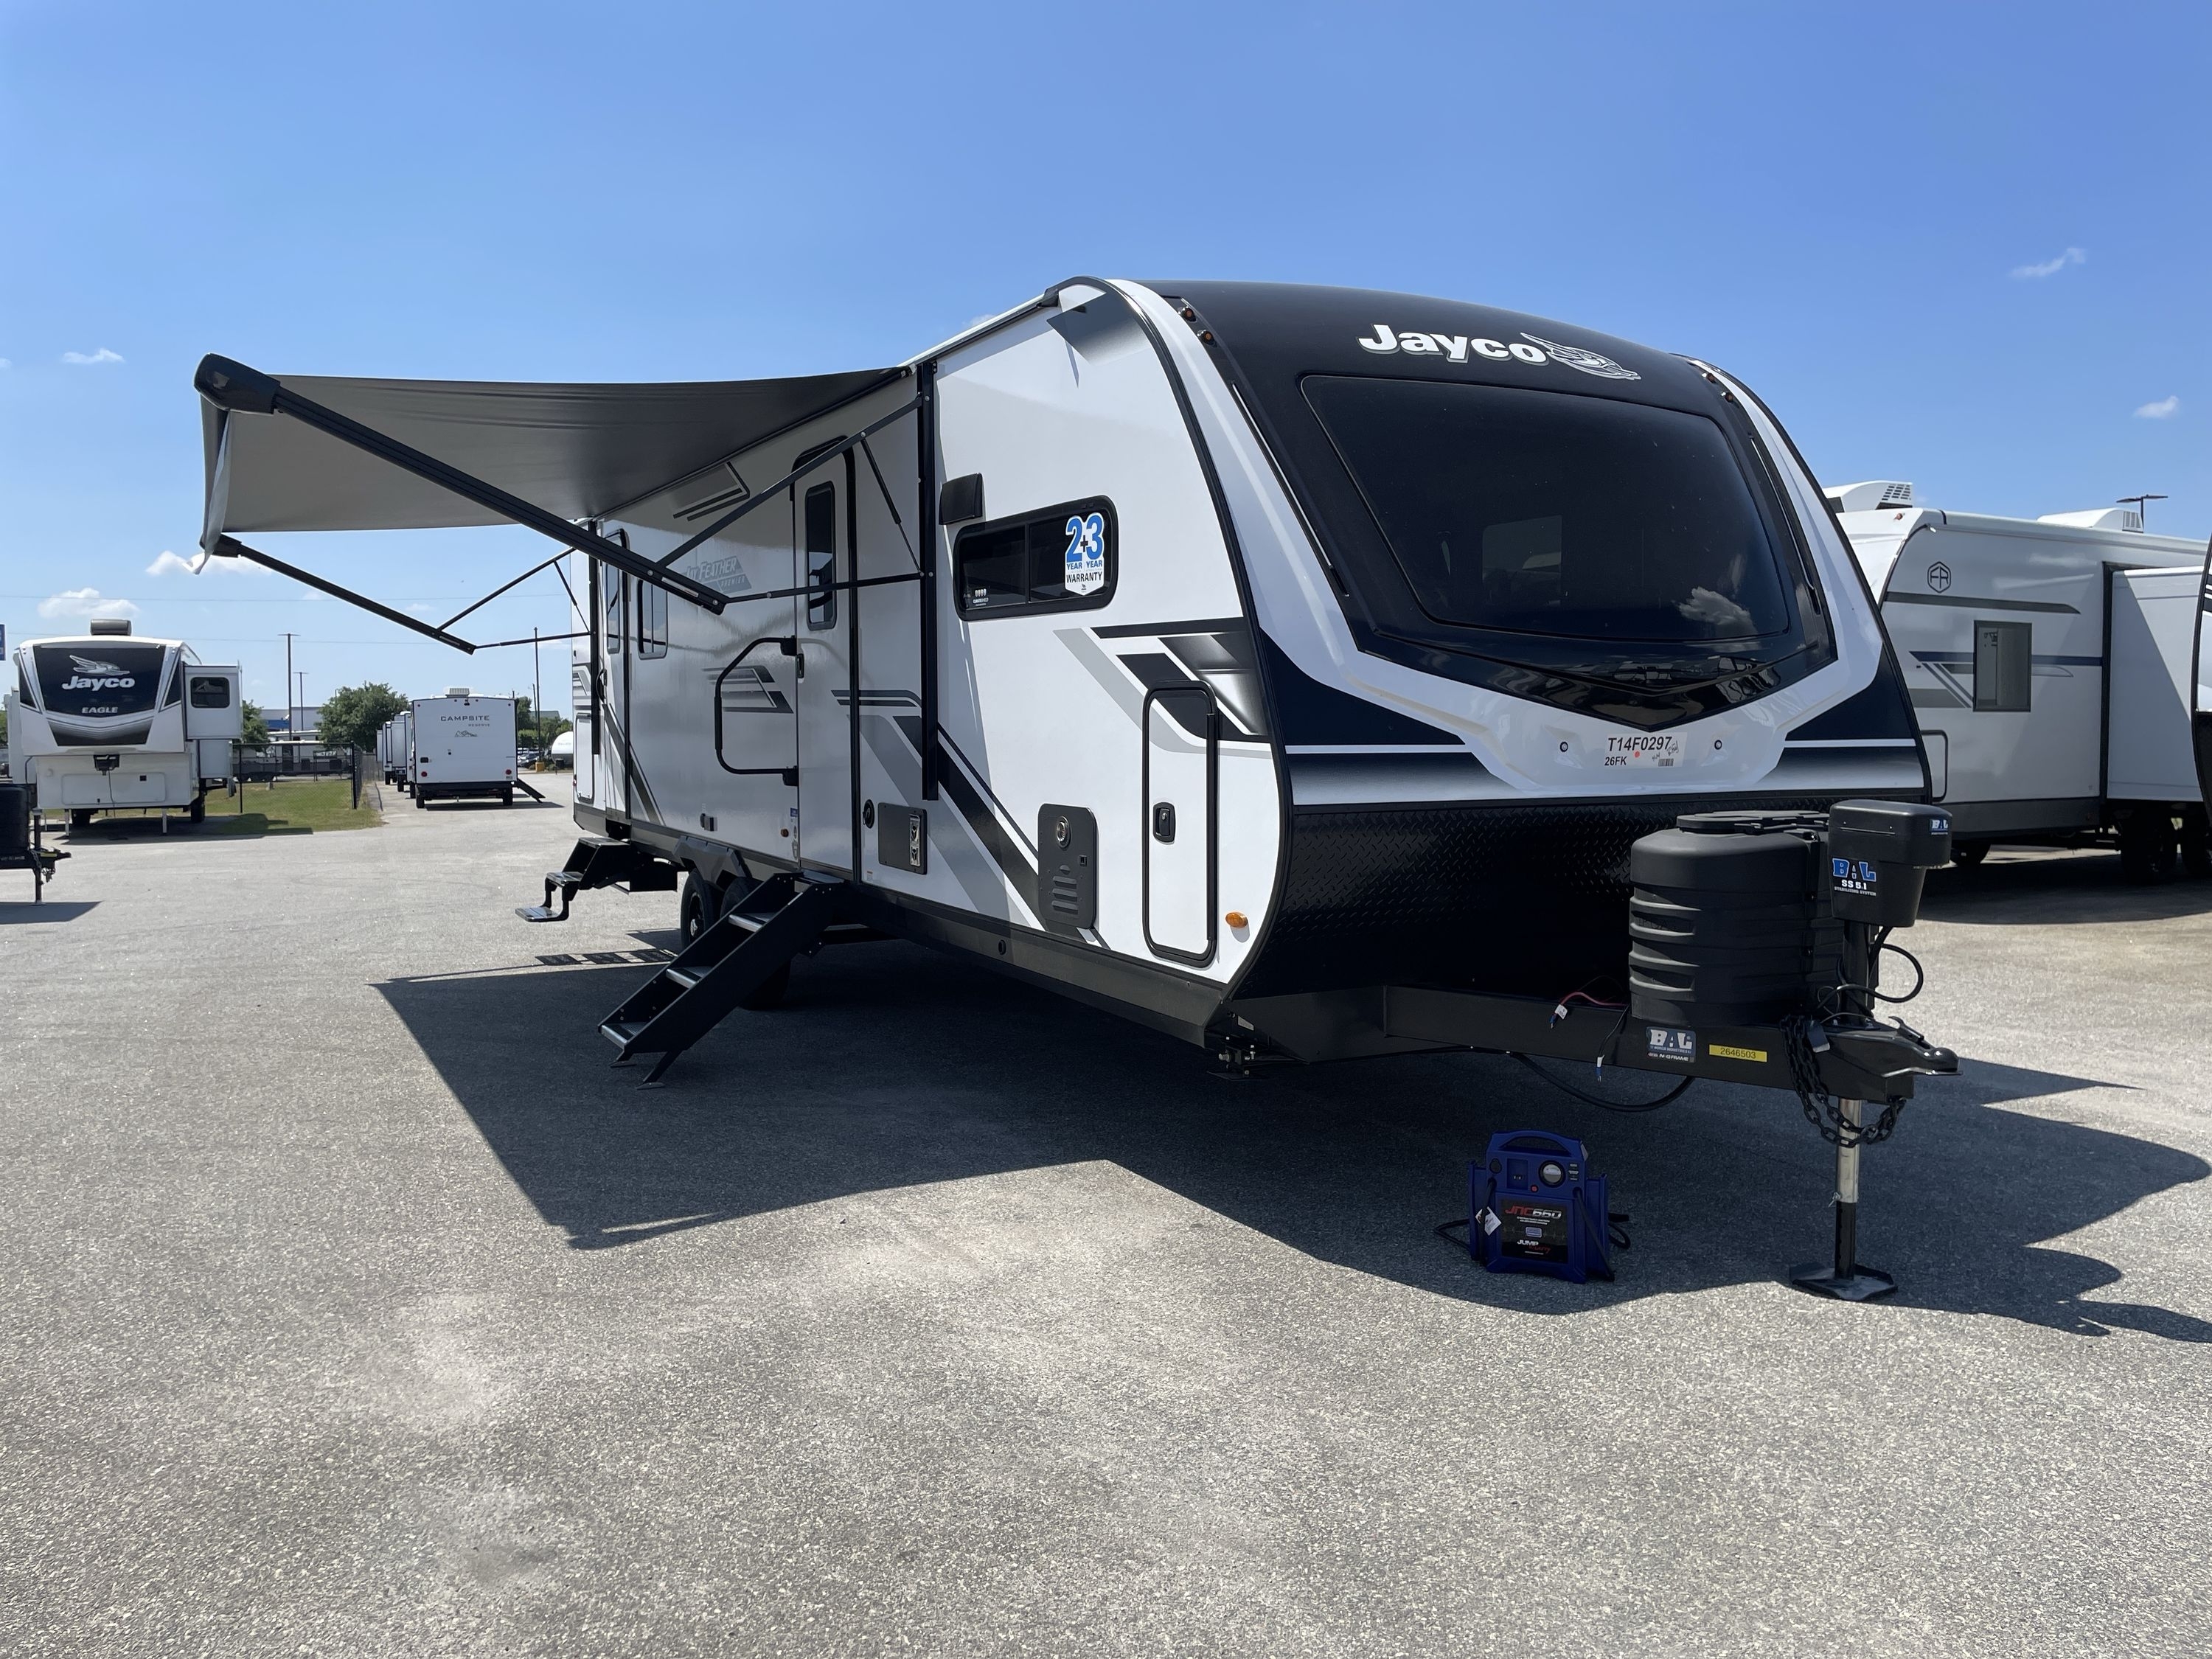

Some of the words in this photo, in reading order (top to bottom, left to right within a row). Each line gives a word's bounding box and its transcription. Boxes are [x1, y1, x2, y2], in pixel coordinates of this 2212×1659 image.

[1356, 324, 1549, 366] Jayco
[1066, 571, 1102, 583] WARRANTY
[61, 675, 135, 692] Jayco
[1608, 736, 1673, 752] T14F0297
[1604, 755, 1627, 766] 26FK
[1832, 858, 1877, 883] BAL
[1841, 879, 1854, 888] SS
[1649, 1029, 1693, 1050] BAL
[1720, 1047, 1756, 1059] 2646503
